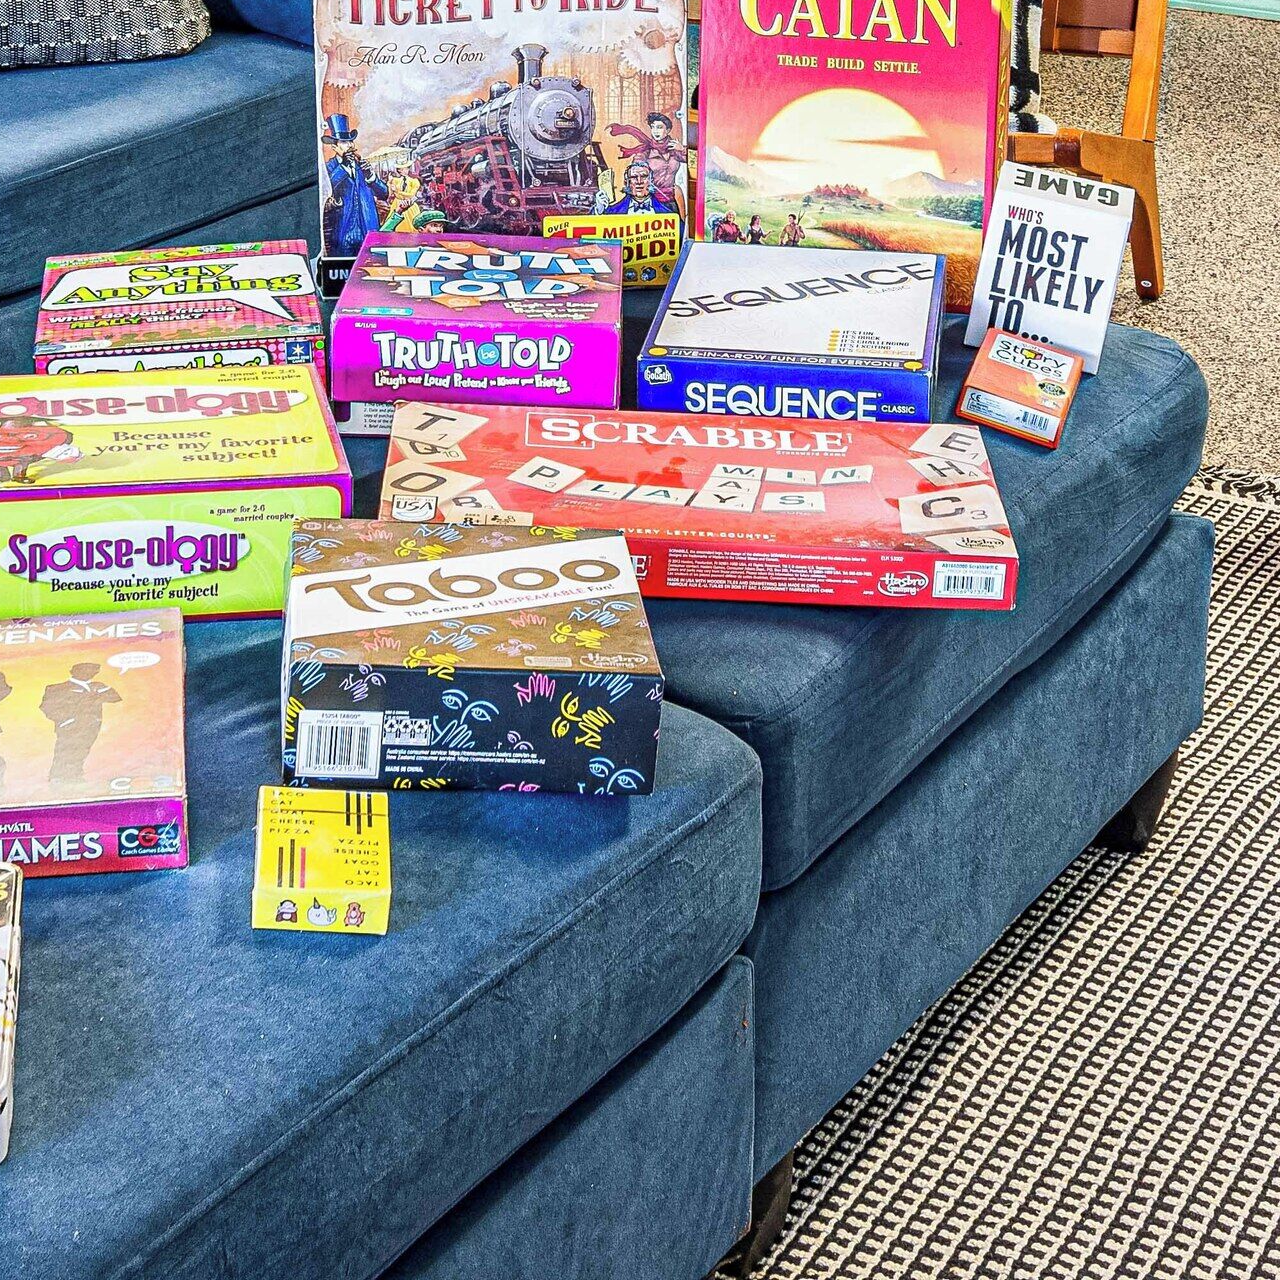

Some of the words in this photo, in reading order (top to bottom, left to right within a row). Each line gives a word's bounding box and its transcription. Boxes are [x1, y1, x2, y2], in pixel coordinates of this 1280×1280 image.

[432, 42, 487, 65] Moon
[777, 54, 818, 68] TRADE
[827, 56, 865, 70] BUILD
[1014, 168, 1120, 208] GAME
[1008, 205, 1044, 225] WHO'S
[547, 221, 570, 234] OVER
[602, 218, 676, 239] MILLION
[635, 234, 652, 243] RIDE
[653, 231, 676, 241] GAMES
[623, 239, 676, 264] OLD!
[998, 220, 1089, 272] MOST
[370, 247, 612, 274] TRUTH
[128, 264, 239, 283] Say
[51, 274, 303, 306] Anything
[393, 275, 580, 299] TOLD
[668, 262, 934, 318] SEQUENCE
[990, 257, 1104, 315] LIKELY
[372, 331, 479, 371] TRUTH
[493, 334, 572, 372] TOLD
[671, 348, 767, 362] FIVE-IN-A-ROW
[770, 355, 797, 363] FUN
[800, 356, 827, 365] FOR
[830, 358, 901, 368] EVERYONE
[373, 371, 407, 390] Laugh
[424, 372, 451, 388] Loud
[684, 381, 878, 422] SEQUENCE
[881, 404, 916, 415] CLASSIC
[91, 440, 171, 458] you're
[178, 440, 212, 452] my
[220, 434, 314, 449] favorite
[113, 429, 212, 443] Because
[540, 417, 849, 454] SCRABBLE
[395, 501, 434, 512] USA
[233, 514, 264, 523] married
[666, 529, 714, 538] LETTER
[720, 531, 771, 540] COUNTS
[7, 525, 239, 584] Spouse-ology
[50, 576, 105, 593] Because
[106, 573, 150, 594] you're
[153, 576, 173, 590] my
[304, 558, 620, 613] Taboo
[880, 572, 927, 589] Hasbro
[113, 588, 164, 603] favorite
[168, 582, 219, 601] subject!
[431, 603, 470, 615] Game
[472, 601, 486, 610] of
[487, 587, 586, 608] UNSPEAKABLE
[269, 827, 311, 835] PIZZA
[270, 818, 316, 826] CHEESE
[333, 848, 380, 857] CHEESE
[337, 838, 380, 847] PIZZA
